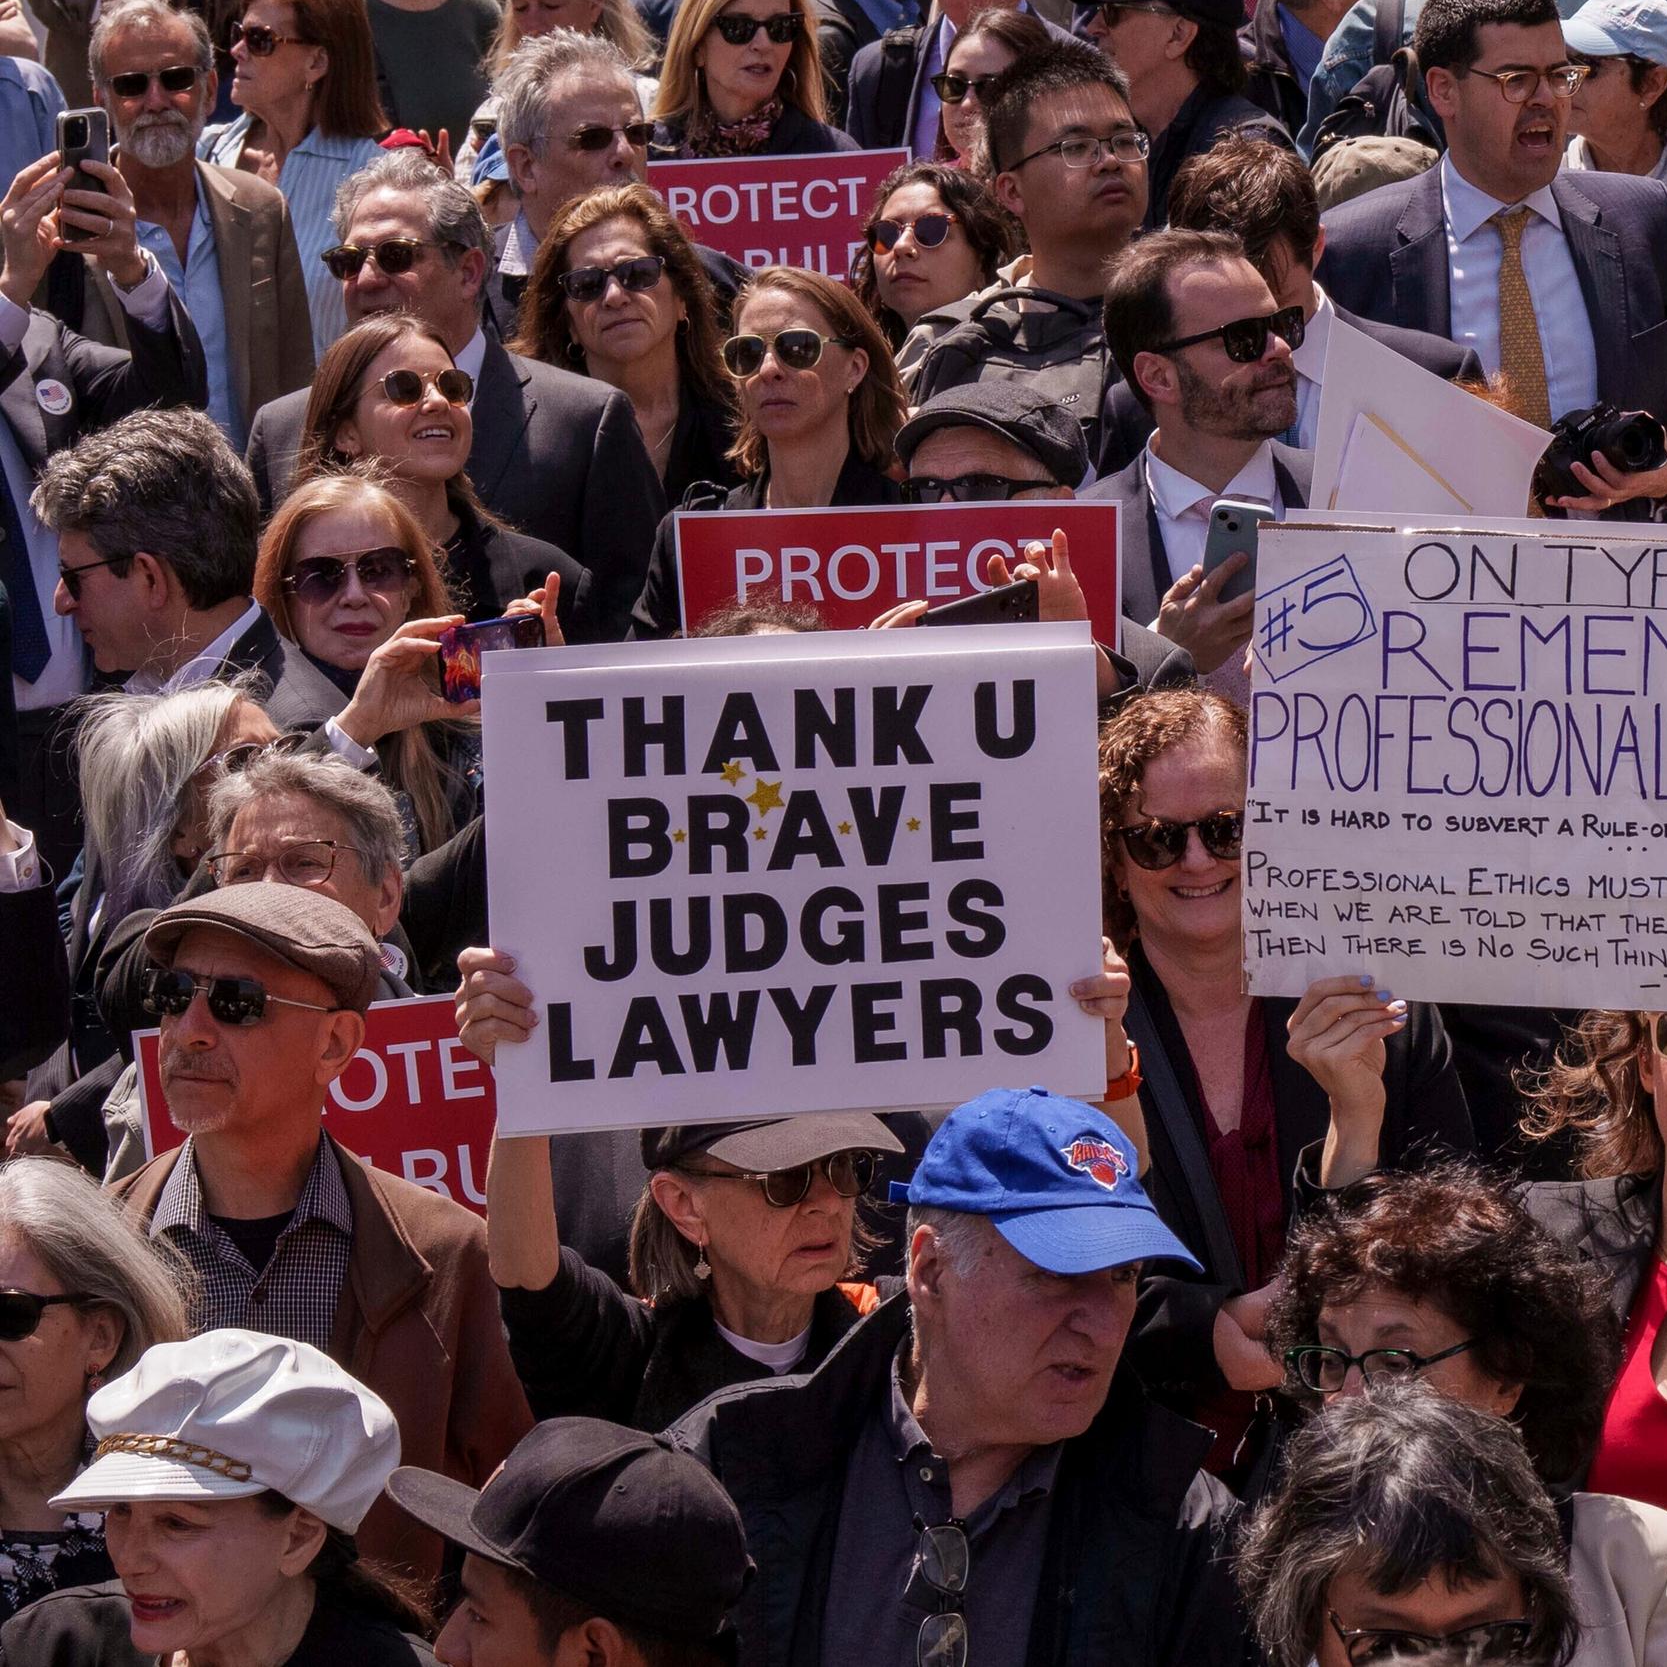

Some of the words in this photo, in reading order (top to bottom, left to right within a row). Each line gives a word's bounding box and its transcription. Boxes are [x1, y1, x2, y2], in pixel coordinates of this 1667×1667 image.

[1403, 542, 1516, 604] ON
[1260, 568, 1368, 659] #5
[545, 681, 936, 783] THANK
[973, 677, 1037, 760] U
[606, 781, 985, 881] BRAVE
[1302, 809, 1320, 825] IS
[1331, 810, 1390, 829] HARD
[1402, 813, 1433, 832] TO
[1445, 814, 1550, 838] SUBVERT
[1557, 818, 1574, 836] A
[1246, 850, 1456, 895] PROFESSIONAL
[1469, 867, 1570, 897] ETHICS
[582, 877, 1007, 983] JUDGES
[1247, 898, 1318, 922] WHEN
[1335, 902, 1374, 923] WE
[1389, 905, 1451, 925] ARE
[1460, 906, 1526, 929] TOLD
[1540, 912, 1606, 934] THAT
[1250, 928, 1326, 959] THEN
[1342, 933, 1426, 957] THERE
[1442, 940, 1466, 957] IS
[1527, 938, 1599, 968] SUCH
[545, 971, 1056, 1083] LAWYERS
